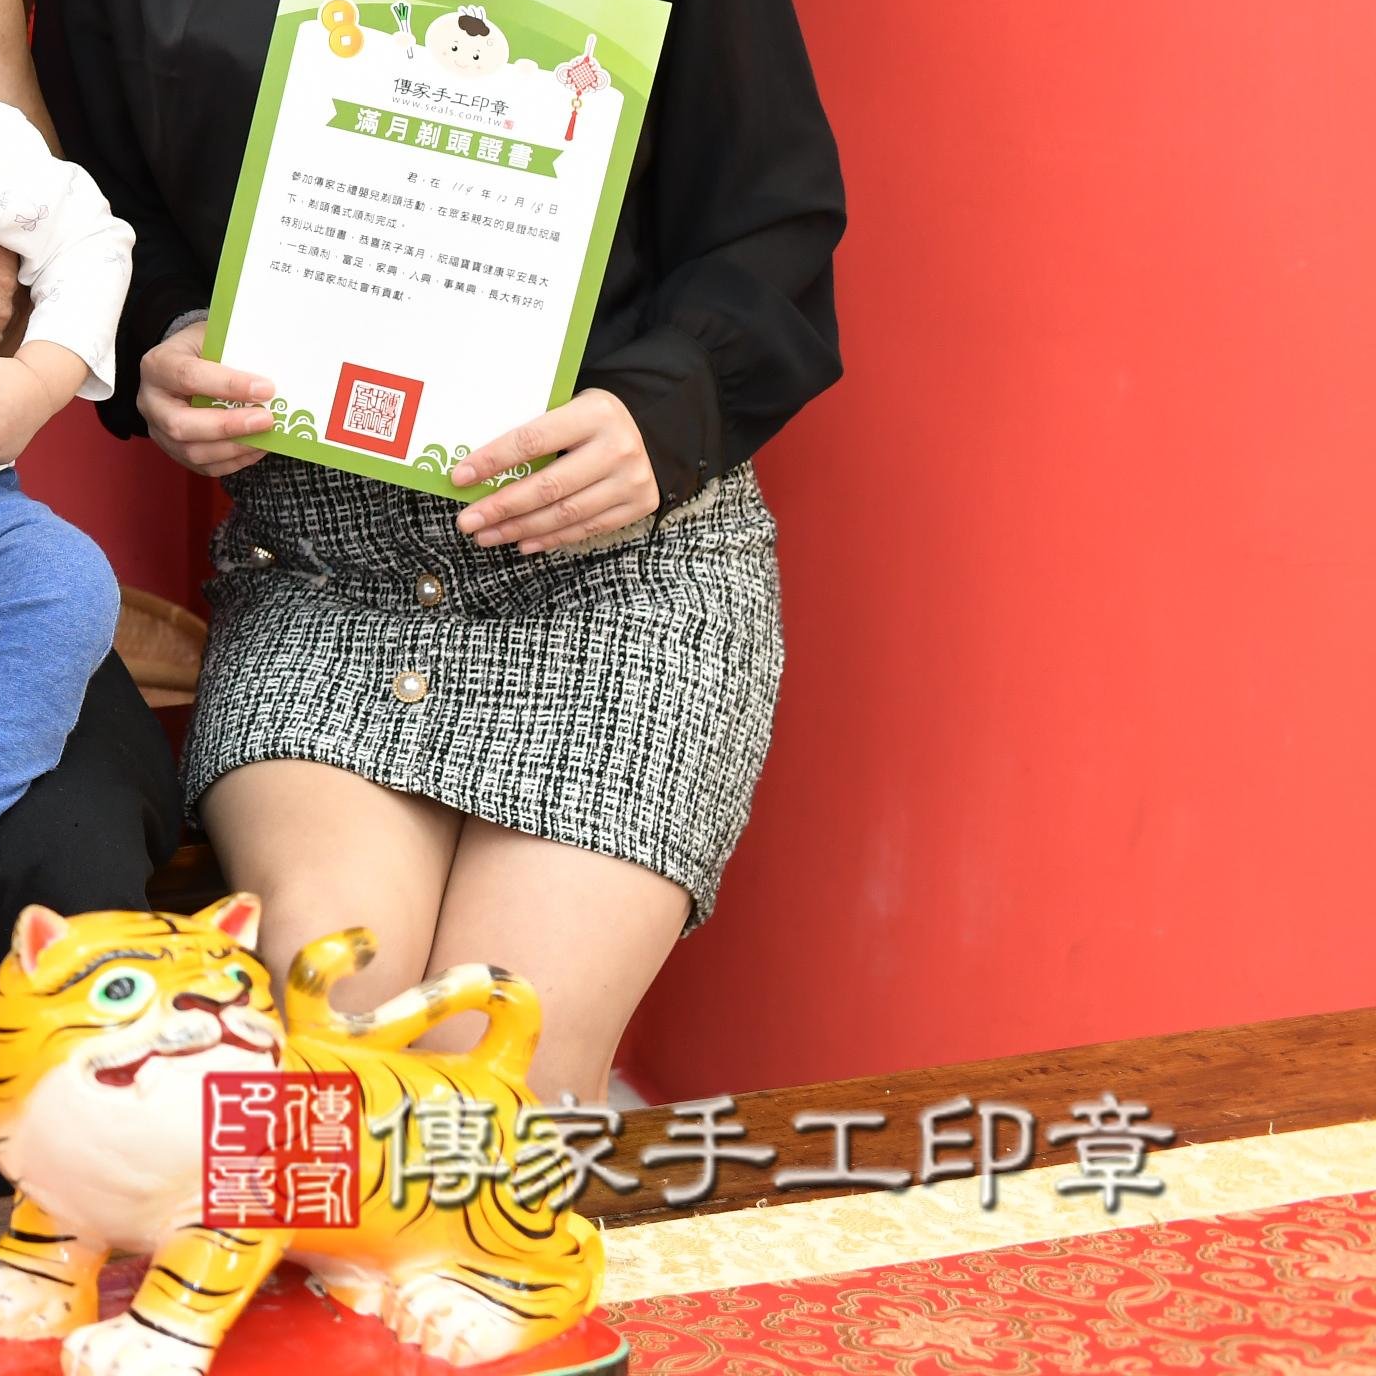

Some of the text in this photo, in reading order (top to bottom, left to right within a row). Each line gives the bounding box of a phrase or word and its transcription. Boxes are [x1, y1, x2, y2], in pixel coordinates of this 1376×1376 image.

[392, 96, 502, 127] www.seals.com.tw
[394, 78, 510, 116] 傳家手工印章
[354, 108, 534, 169] 滿月剃頭證書
